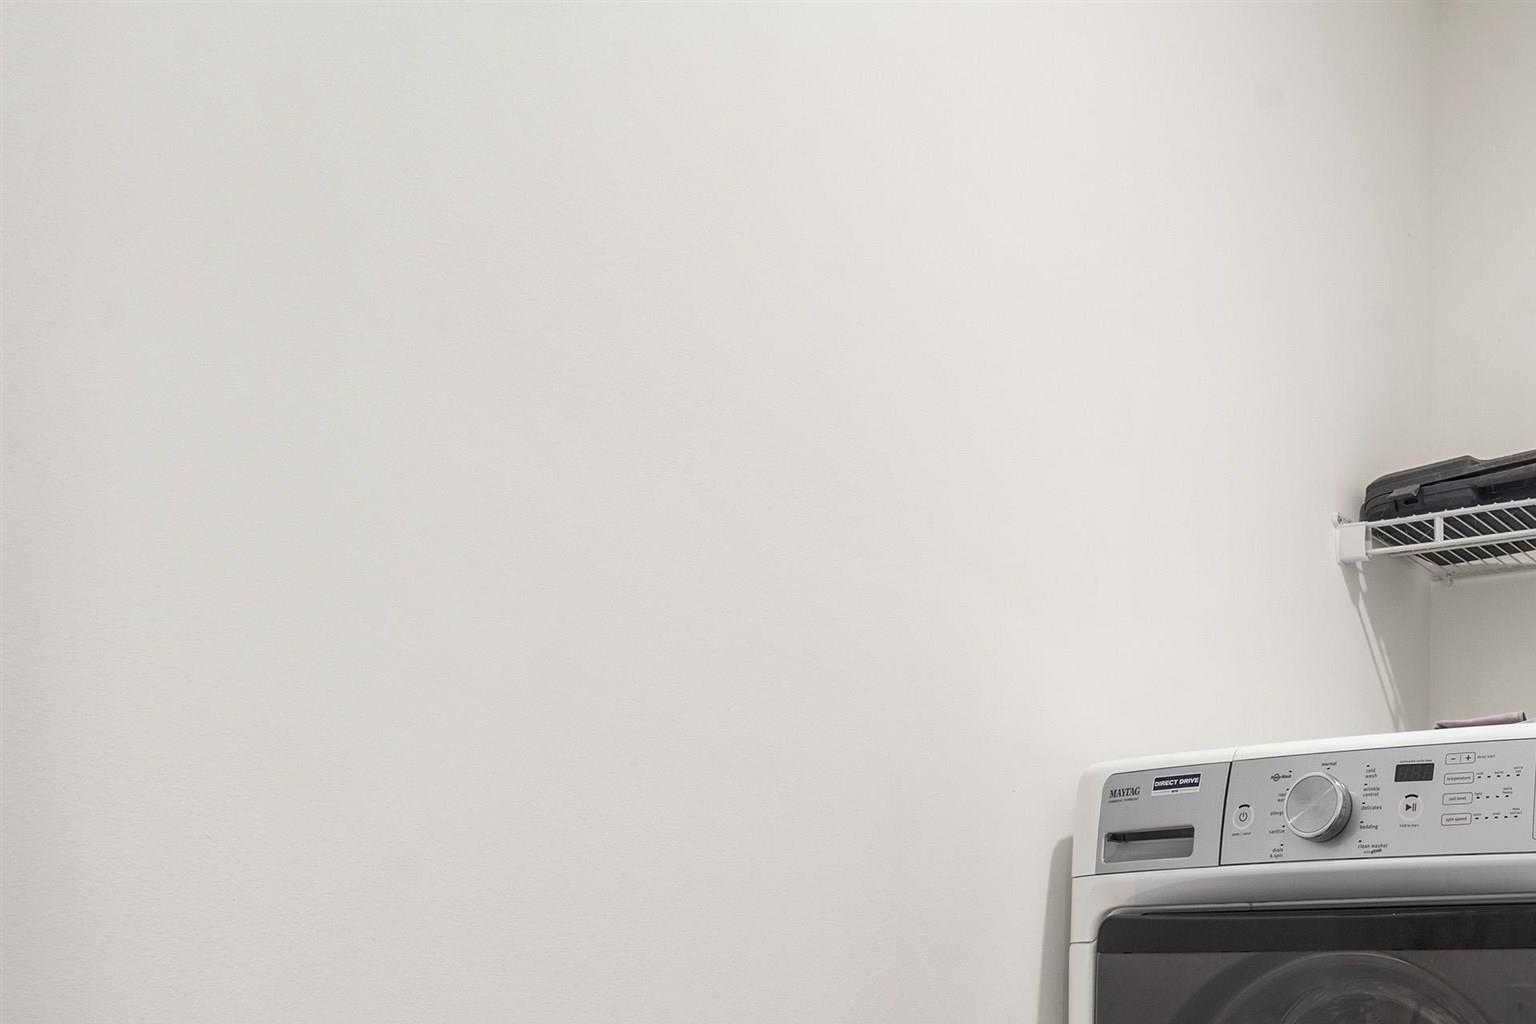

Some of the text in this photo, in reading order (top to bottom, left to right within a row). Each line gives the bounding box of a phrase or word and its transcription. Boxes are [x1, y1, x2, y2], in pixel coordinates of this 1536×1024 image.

[1154, 777, 1200, 787] DIRECT DRIVE
[1109, 786, 1141, 799] MAYTAG
